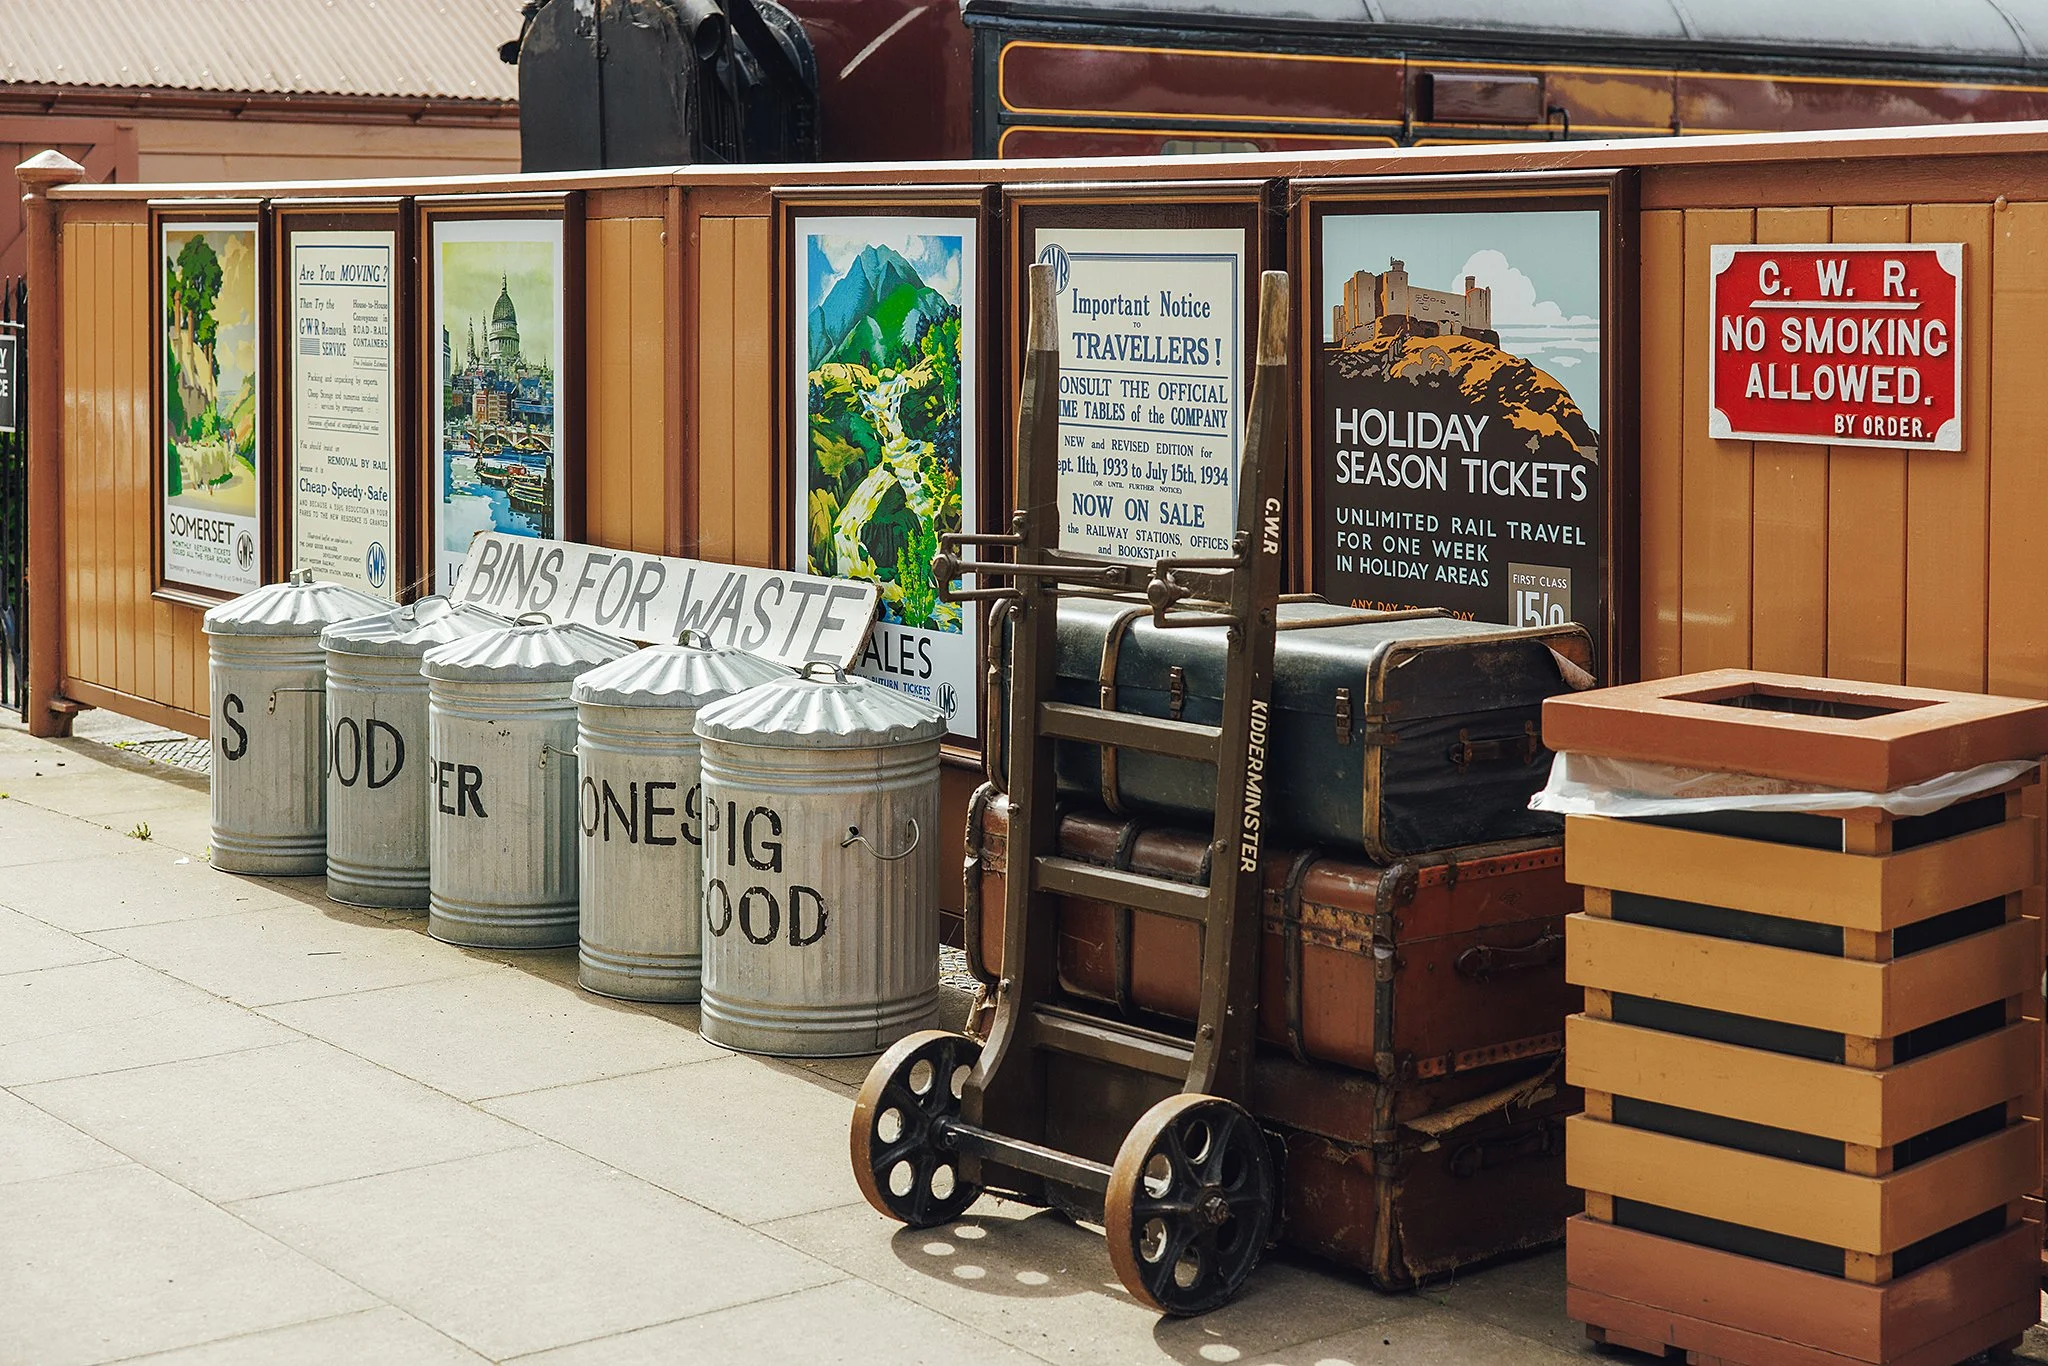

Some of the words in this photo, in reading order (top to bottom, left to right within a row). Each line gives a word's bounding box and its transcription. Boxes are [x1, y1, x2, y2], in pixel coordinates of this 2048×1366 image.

[299, 264, 315, 281] Are
[319, 264, 336, 281] You
[1815, 259, 1855, 297] W.
[1883, 259, 1919, 297] R.
[326, 298, 335, 310] the
[1072, 288, 1150, 321] Important
[1160, 290, 1211, 318] Notice
[322, 321, 347, 336] Removals
[353, 338, 388, 348] CONTAINERS
[1721, 315, 1766, 351] NO
[1781, 316, 1948, 357] SMOKING
[322, 342, 347, 356] SERVICE
[1060, 375, 1112, 397] ONSULT
[1120, 379, 1150, 398] THE
[1158, 382, 1228, 404] OFFICIAL
[1745, 362, 1934, 406] ALLOWED.
[1059, 399, 1078, 418] IME
[1084, 401, 1125, 422] TABLES
[1131, 404, 1141, 423] of
[1148, 406, 1165, 424] the
[1171, 407, 1228, 428] COMPANY
[1834, 414, 1858, 435] BY
[1863, 416, 1933, 438] ORDER.
[1335, 408, 1490, 452] HOLIDAY
[1064, 435, 1085, 448] NEW
[1091, 438, 1105, 449] and
[1111, 440, 1150, 453] REVISED
[1156, 443, 1194, 457] EDITION
[1201, 447, 1213, 458] for
[328, 456, 358, 468] REMOVAL
[361, 458, 370, 469] BY
[373, 460, 388, 471] RAIL
[1058, 457, 1074, 477] ept.
[1102, 457, 1128, 476] 1933
[1131, 463, 1142, 478] to
[1145, 461, 1168, 485] July
[1200, 465, 1229, 486] 1934
[1335, 450, 1447, 491] SEASON
[1461, 458, 1588, 502] TICKETS
[1108, 481, 1124, 489] UNTIL
[1128, 483, 1155, 492] FURTHER
[1072, 492, 1114, 520] NOW
[1124, 498, 1149, 522] ON
[1159, 502, 1205, 528] SALE
[170, 513, 235, 545] SOMERSET
[1067, 523, 1080, 535] the
[1086, 524, 1129, 540] RAILWAY
[1190, 535, 1229, 551] OFFICES
[1336, 507, 1440, 533] UNLIMITED
[1451, 517, 1497, 538] RAIL
[1506, 521, 1586, 546] TRAVEL
[1098, 543, 1112, 555] and
[1337, 531, 1373, 551] FOR
[1382, 535, 1421, 556] ONE
[1432, 540, 1489, 562] WEEK
[1336, 554, 1353, 572] IN
[1359, 557, 1429, 581] HOLIDAY
[1434, 565, 1489, 588] AREAS
[1513, 574, 1536, 585] FIRST
[1540, 576, 1568, 589] CLASS
[467, 540, 565, 611] BINS
[564, 554, 667, 632] FOR
[673, 568, 867, 664] WASTE
[1350, 598, 1373, 610] ANY
[1377, 601, 1399, 612] DAY
[861, 631, 932, 679] ALES
[903, 682, 931, 695] TICKETS
[1240, 699, 1269, 873] KIDDERMINSTER
[705, 796, 782, 873] PIG
[703, 878, 828, 947] OOD
